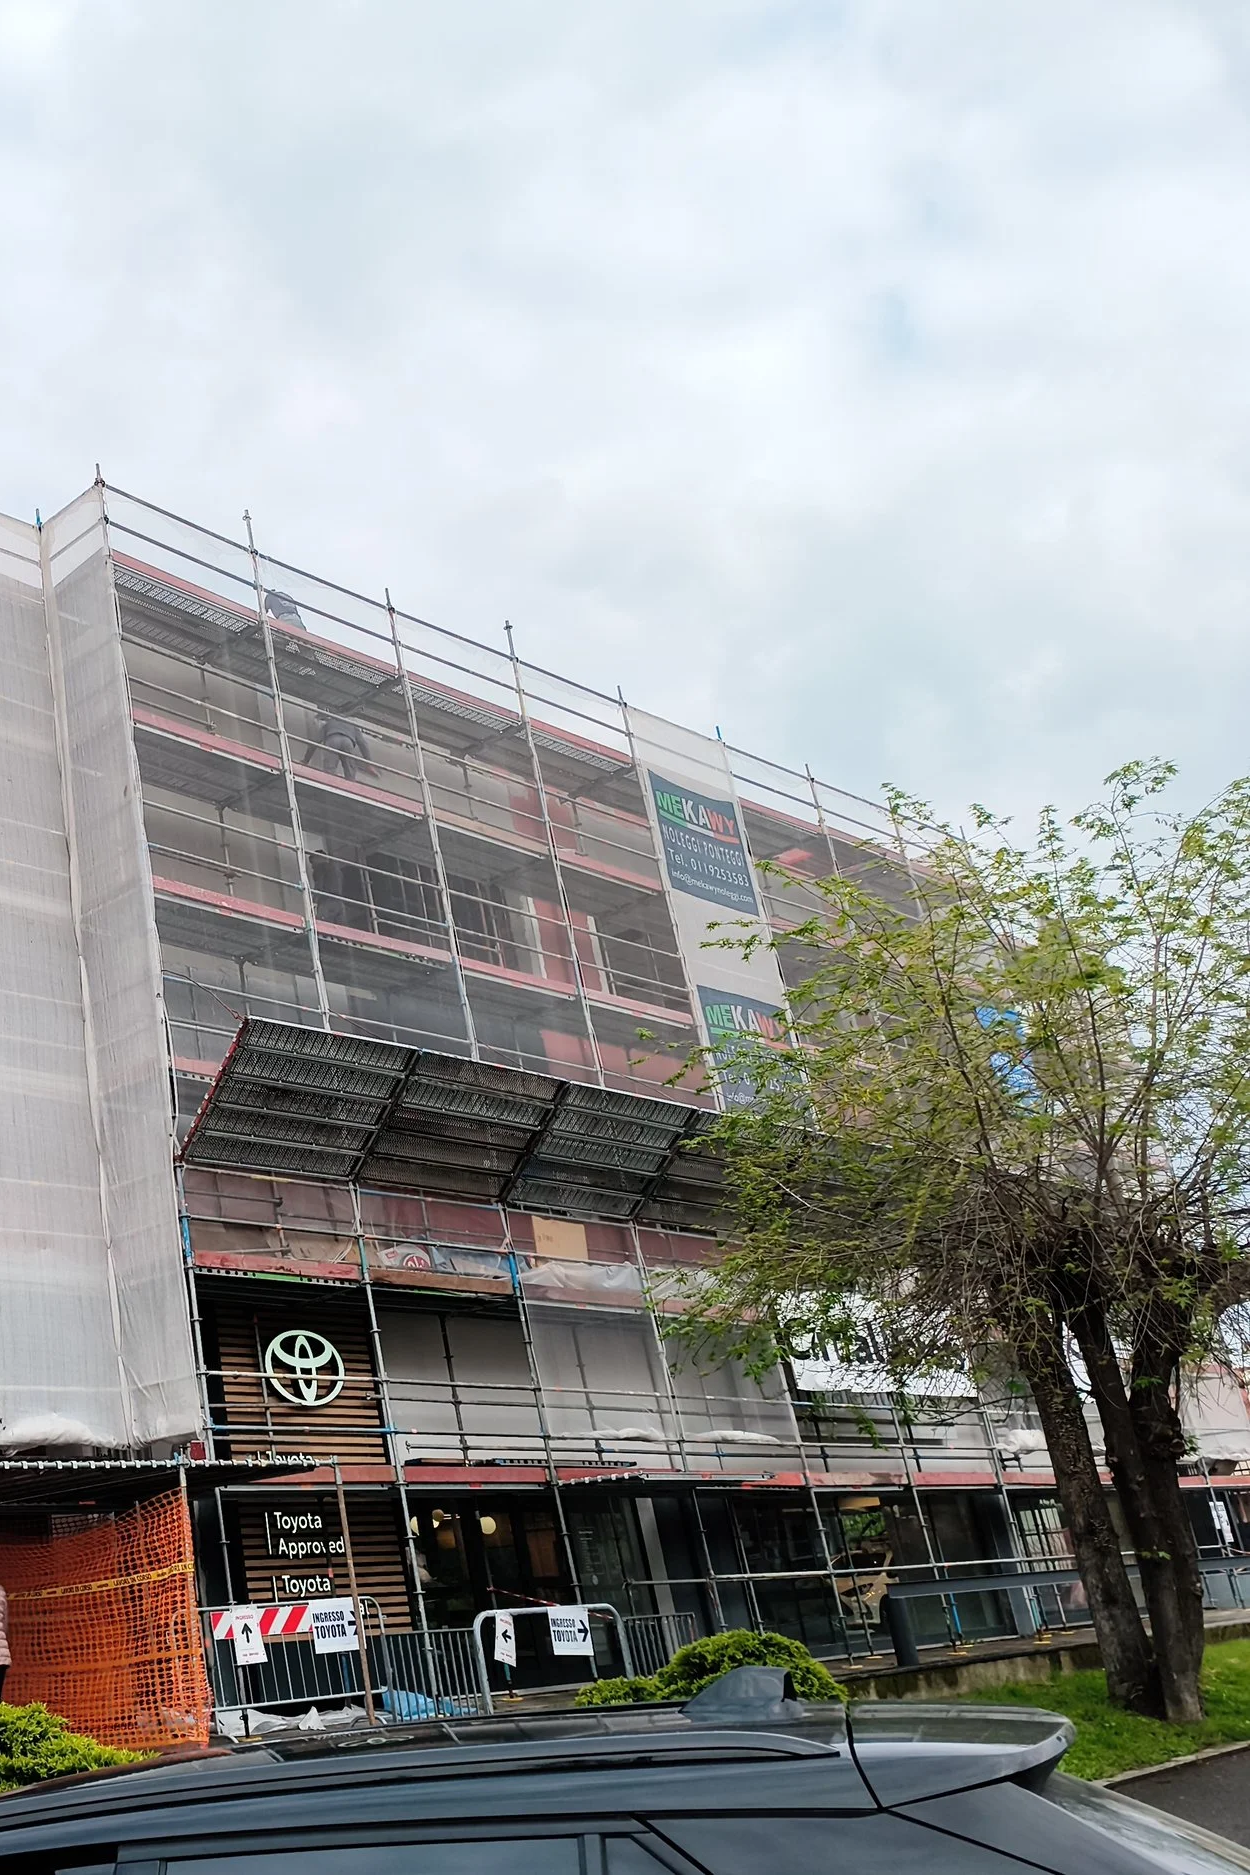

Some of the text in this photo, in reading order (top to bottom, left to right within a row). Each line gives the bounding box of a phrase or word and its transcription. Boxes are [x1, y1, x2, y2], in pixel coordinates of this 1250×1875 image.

[655, 790, 735, 836] MEKAWY
[661, 823, 745, 868] NOLEGGI PONTEGGI
[668, 848, 750, 887] Tel. 0119253583
[672, 868, 754, 903] info@mekawynoleggi.com
[274, 1511, 322, 1533] Toyota
[282, 1575, 331, 1597] Toyota
[312, 1611, 345, 1623] INGRESSO
[551, 1618, 576, 1628] INGRESSO
[315, 1624, 347, 1640] TOYOTA
[553, 1630, 578, 1642] TOYOTA
